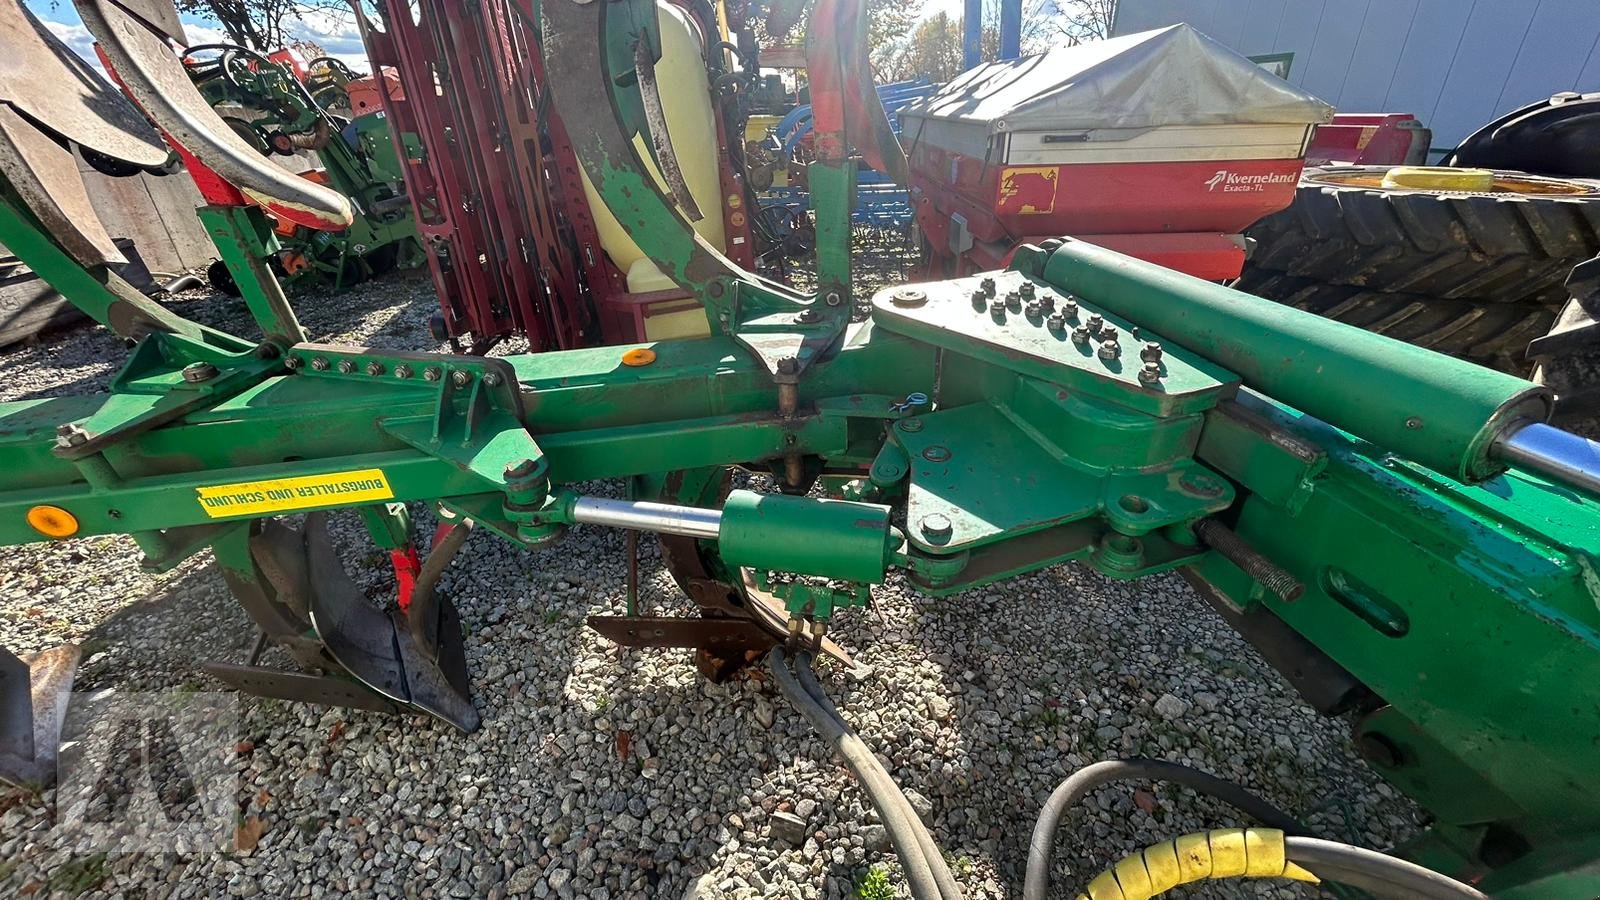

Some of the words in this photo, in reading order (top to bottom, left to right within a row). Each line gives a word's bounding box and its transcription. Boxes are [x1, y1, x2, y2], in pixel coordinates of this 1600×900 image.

[1227, 172, 1297, 184] Kverneland
[1223, 184, 1264, 193] Exacta-TL
[296, 478, 385, 497] BURGSTALLER
[204, 492, 266, 507] SCHLUND
[266, 488, 295, 501] UND
